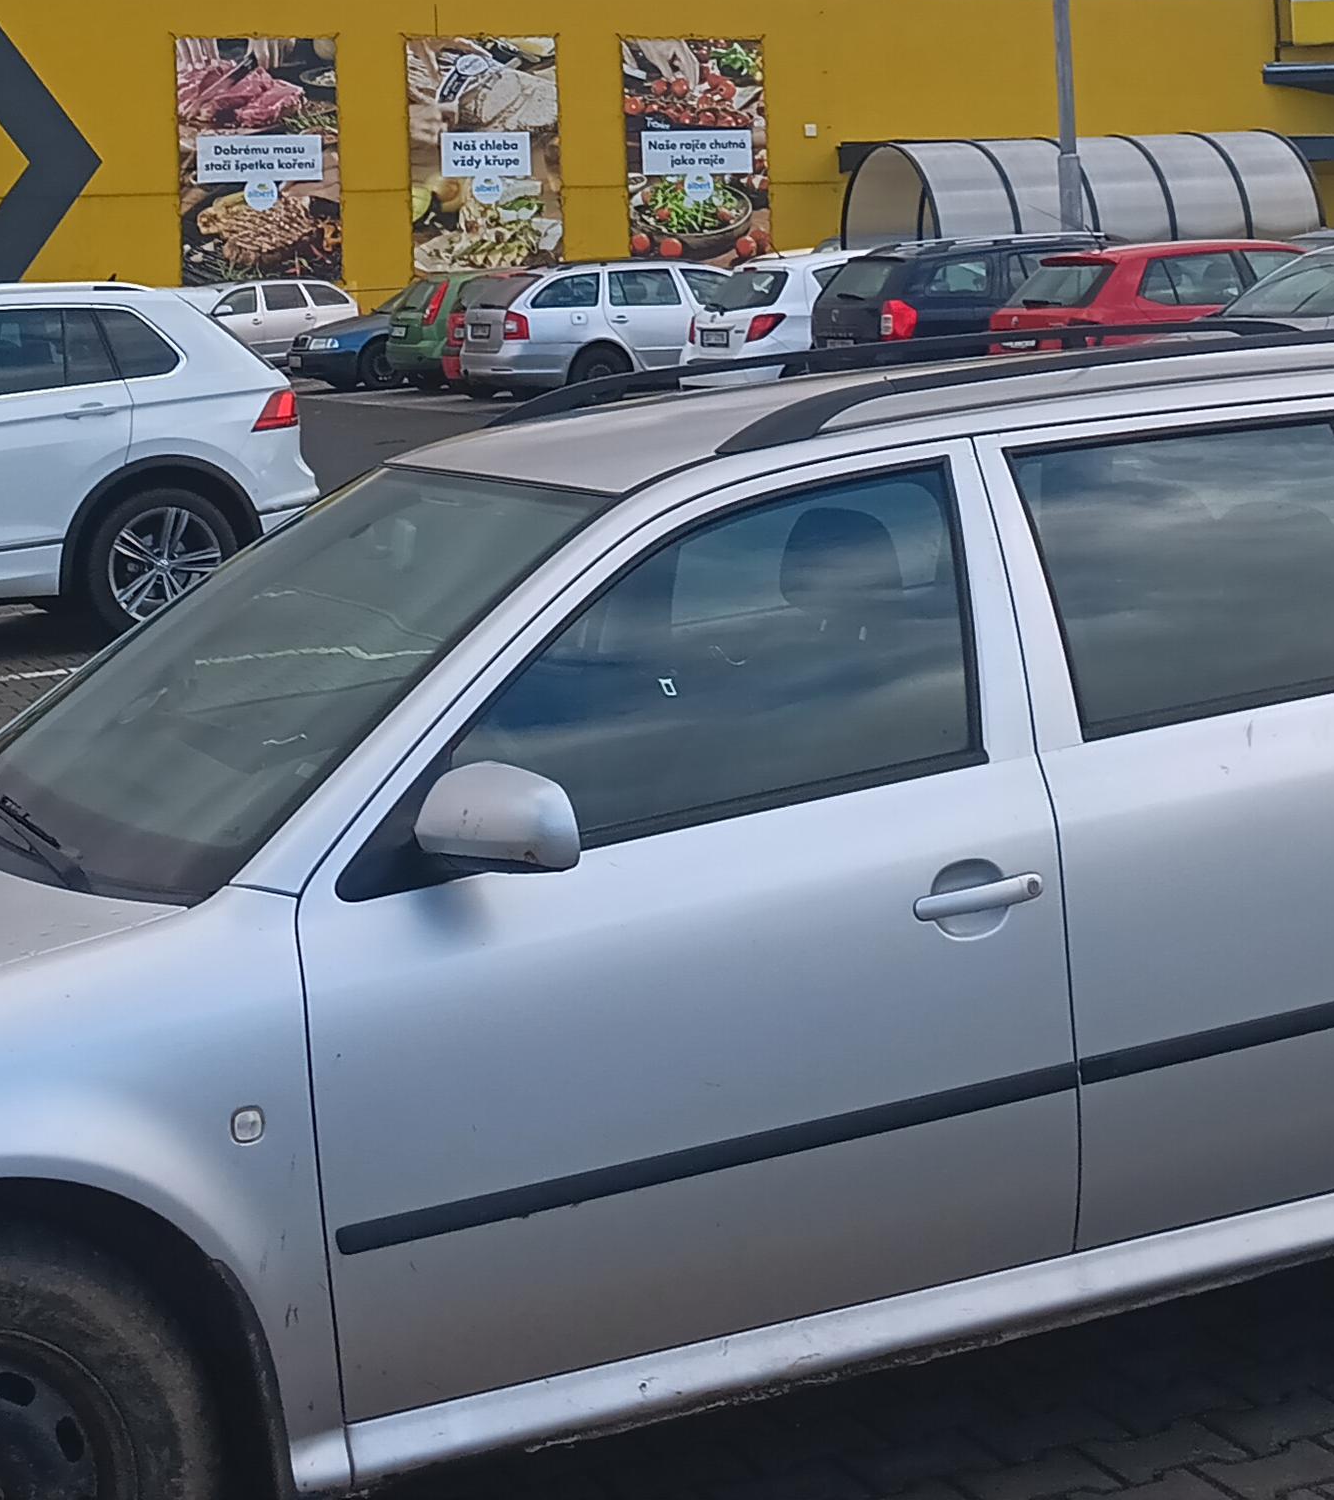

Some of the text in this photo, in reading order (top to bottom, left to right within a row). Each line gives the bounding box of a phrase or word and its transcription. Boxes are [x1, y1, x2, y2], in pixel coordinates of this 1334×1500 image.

[214, 145, 305, 156] Dobrému masu
[453, 140, 518, 151] Náš chleba
[648, 139, 746, 152] Naše rajče chutná
[205, 158, 315, 172] stačí špetka koření
[452, 155, 520, 169] vždy křupe
[670, 154, 725, 168] jako rajče
